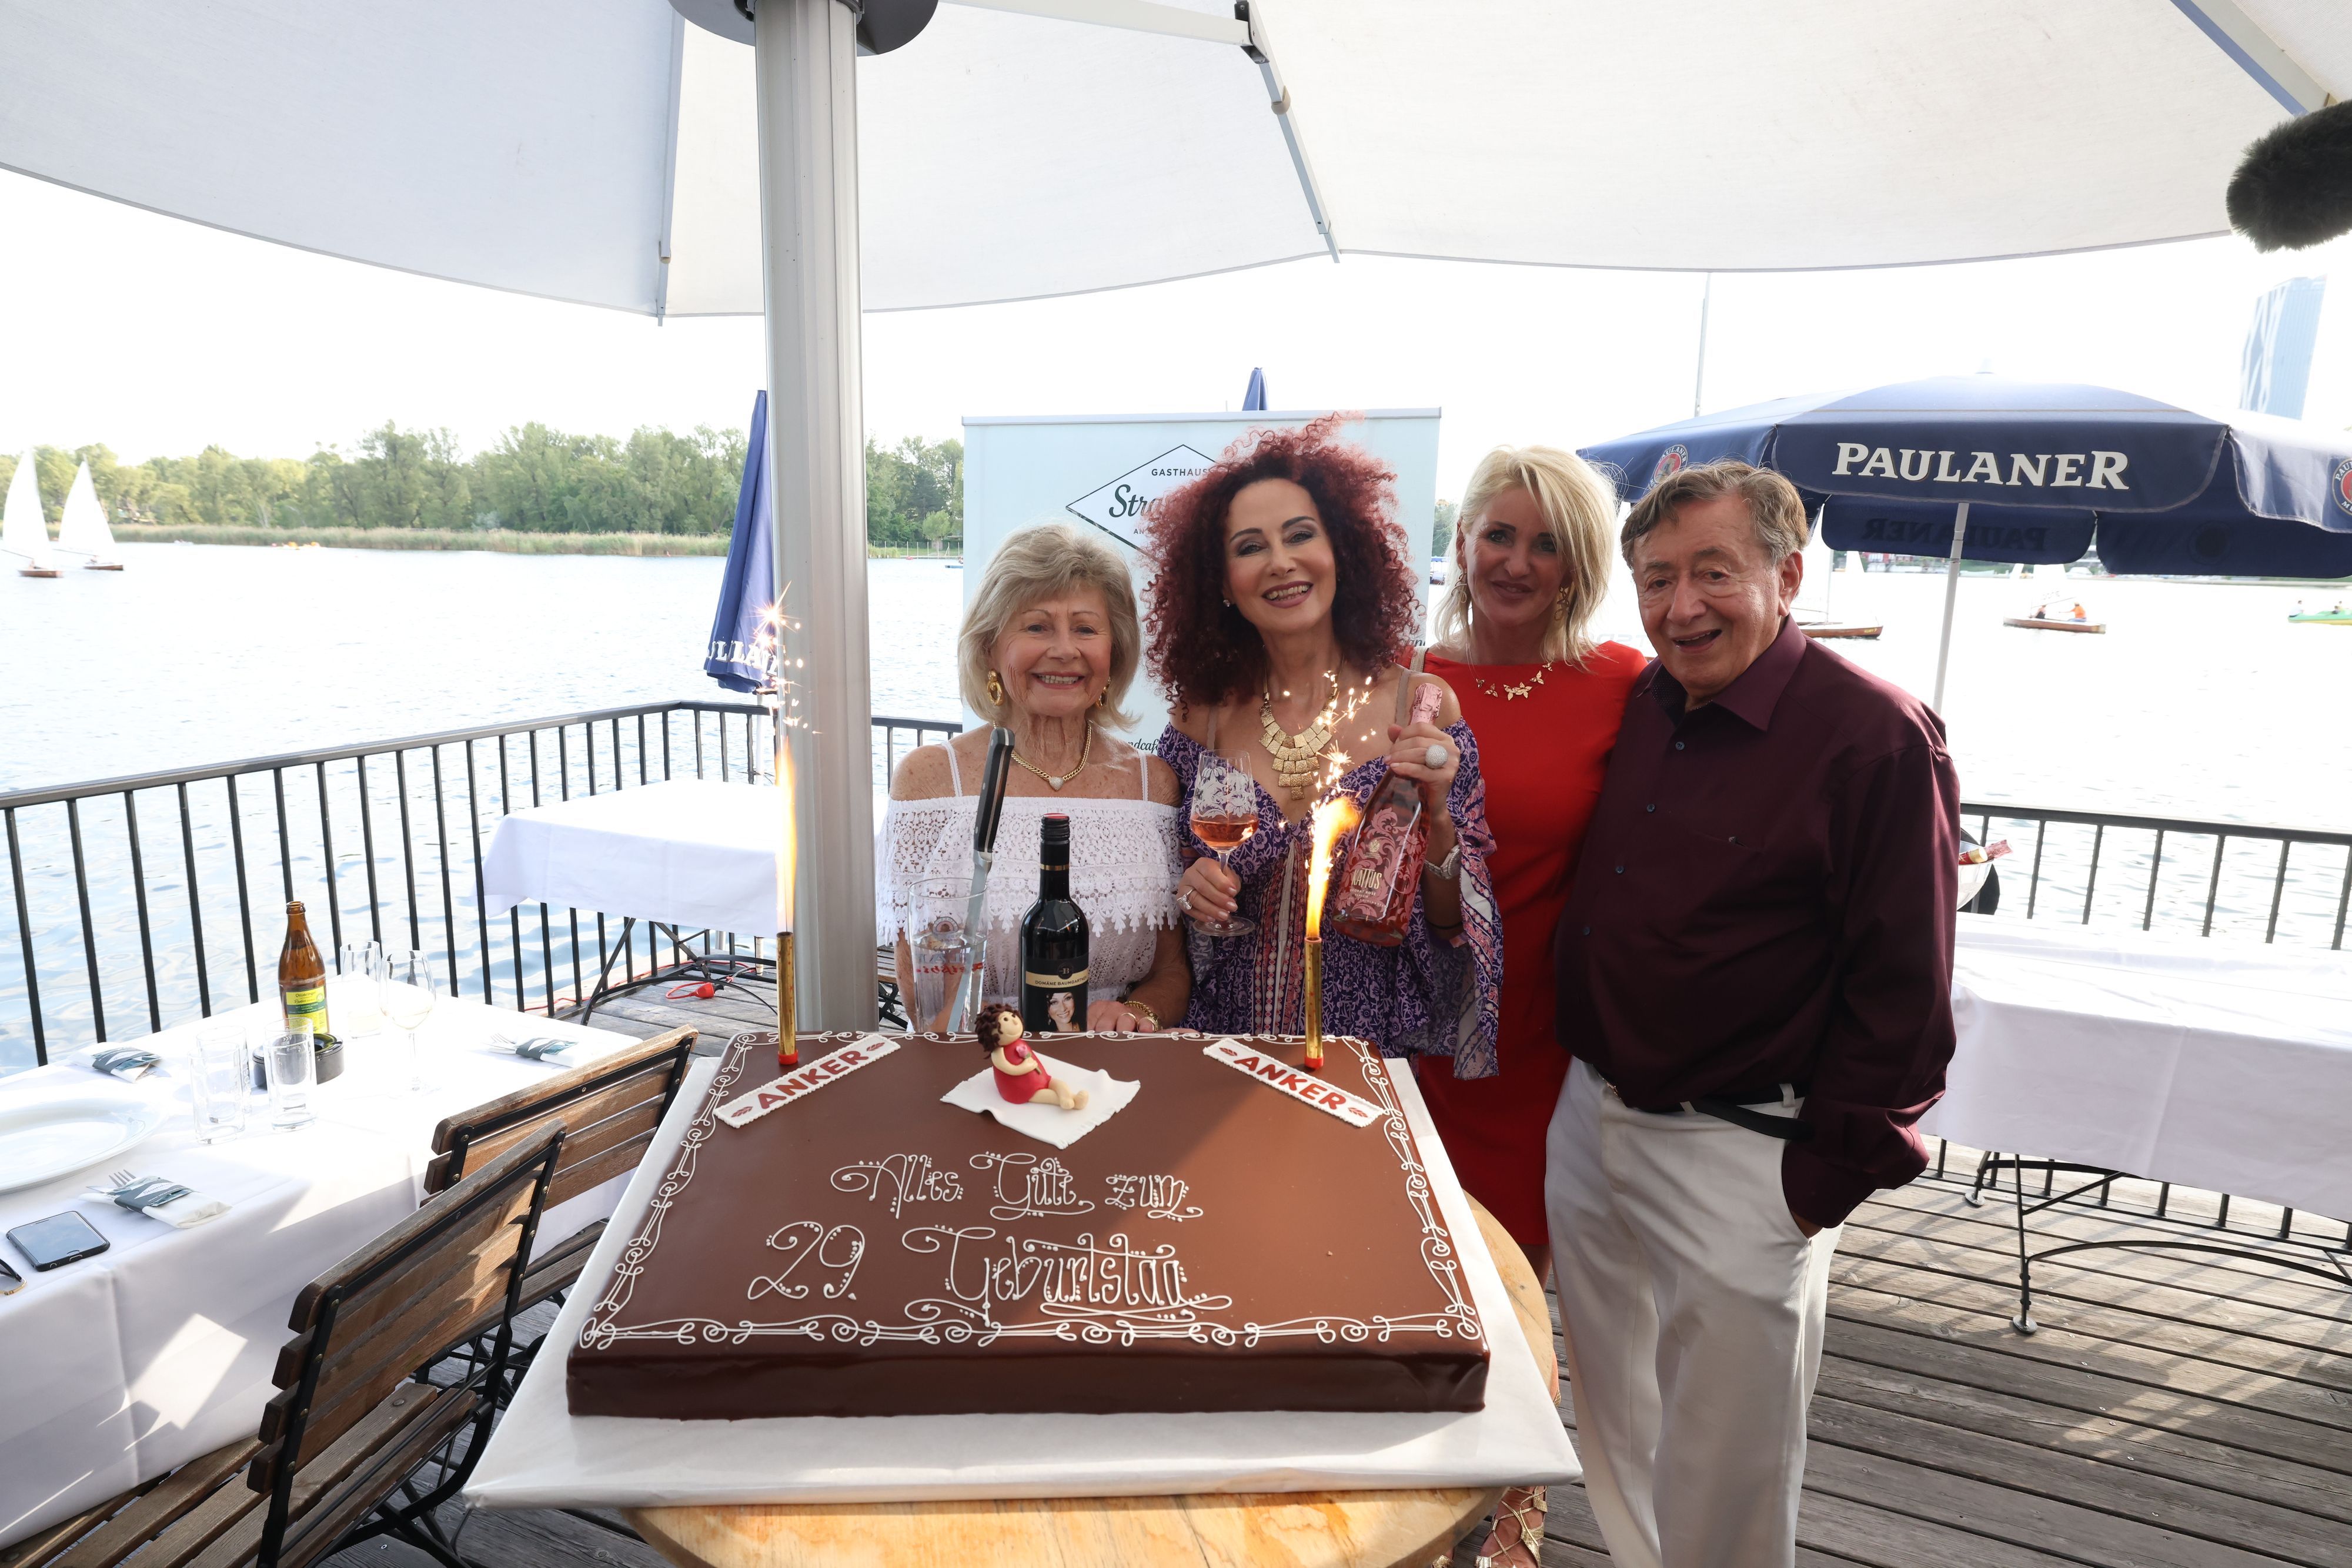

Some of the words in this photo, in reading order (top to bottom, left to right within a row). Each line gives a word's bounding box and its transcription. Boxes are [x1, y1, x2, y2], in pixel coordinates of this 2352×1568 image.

[1832, 442, 2130, 490] PAULANER
[1351, 868, 1382, 889] KATTUS
[758, 1051, 869, 1109] ANKER
[1234, 1057, 1347, 1110] ANKER
[830, 1154, 964, 1219] Alles
[970, 1151, 1095, 1221] Gute
[1104, 1174, 1204, 1222] zum
